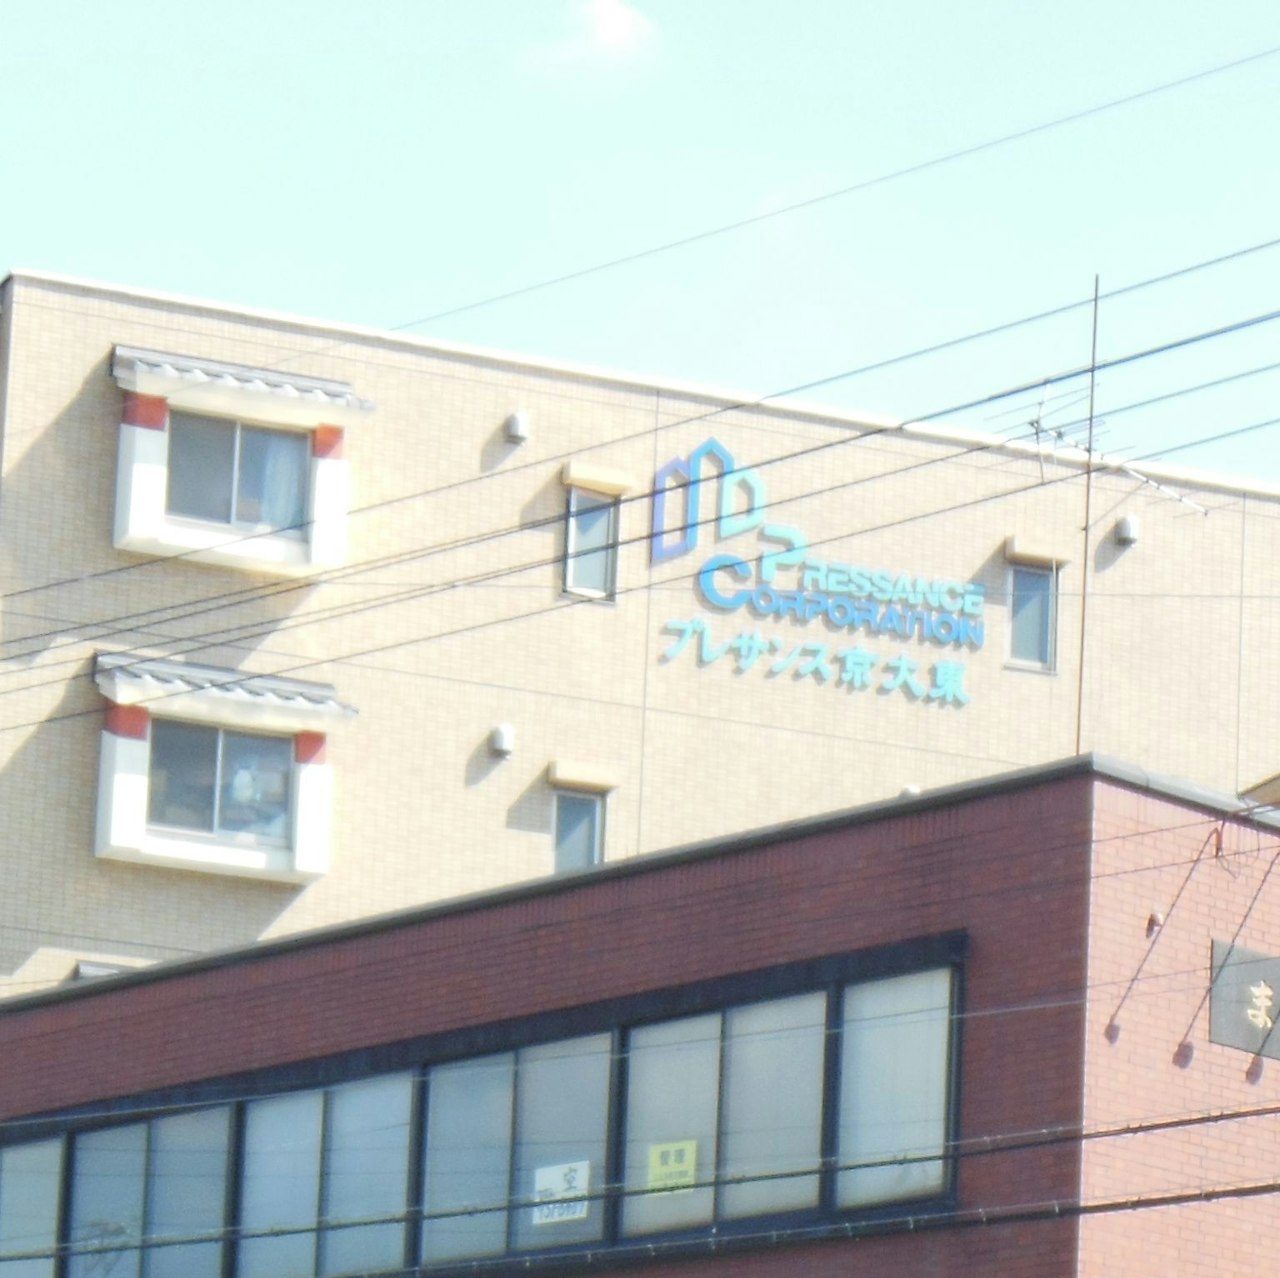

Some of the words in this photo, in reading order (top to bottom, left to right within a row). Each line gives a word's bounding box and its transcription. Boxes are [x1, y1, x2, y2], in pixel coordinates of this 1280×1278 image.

[661, 617, 971, 705] プレサンス京大東
